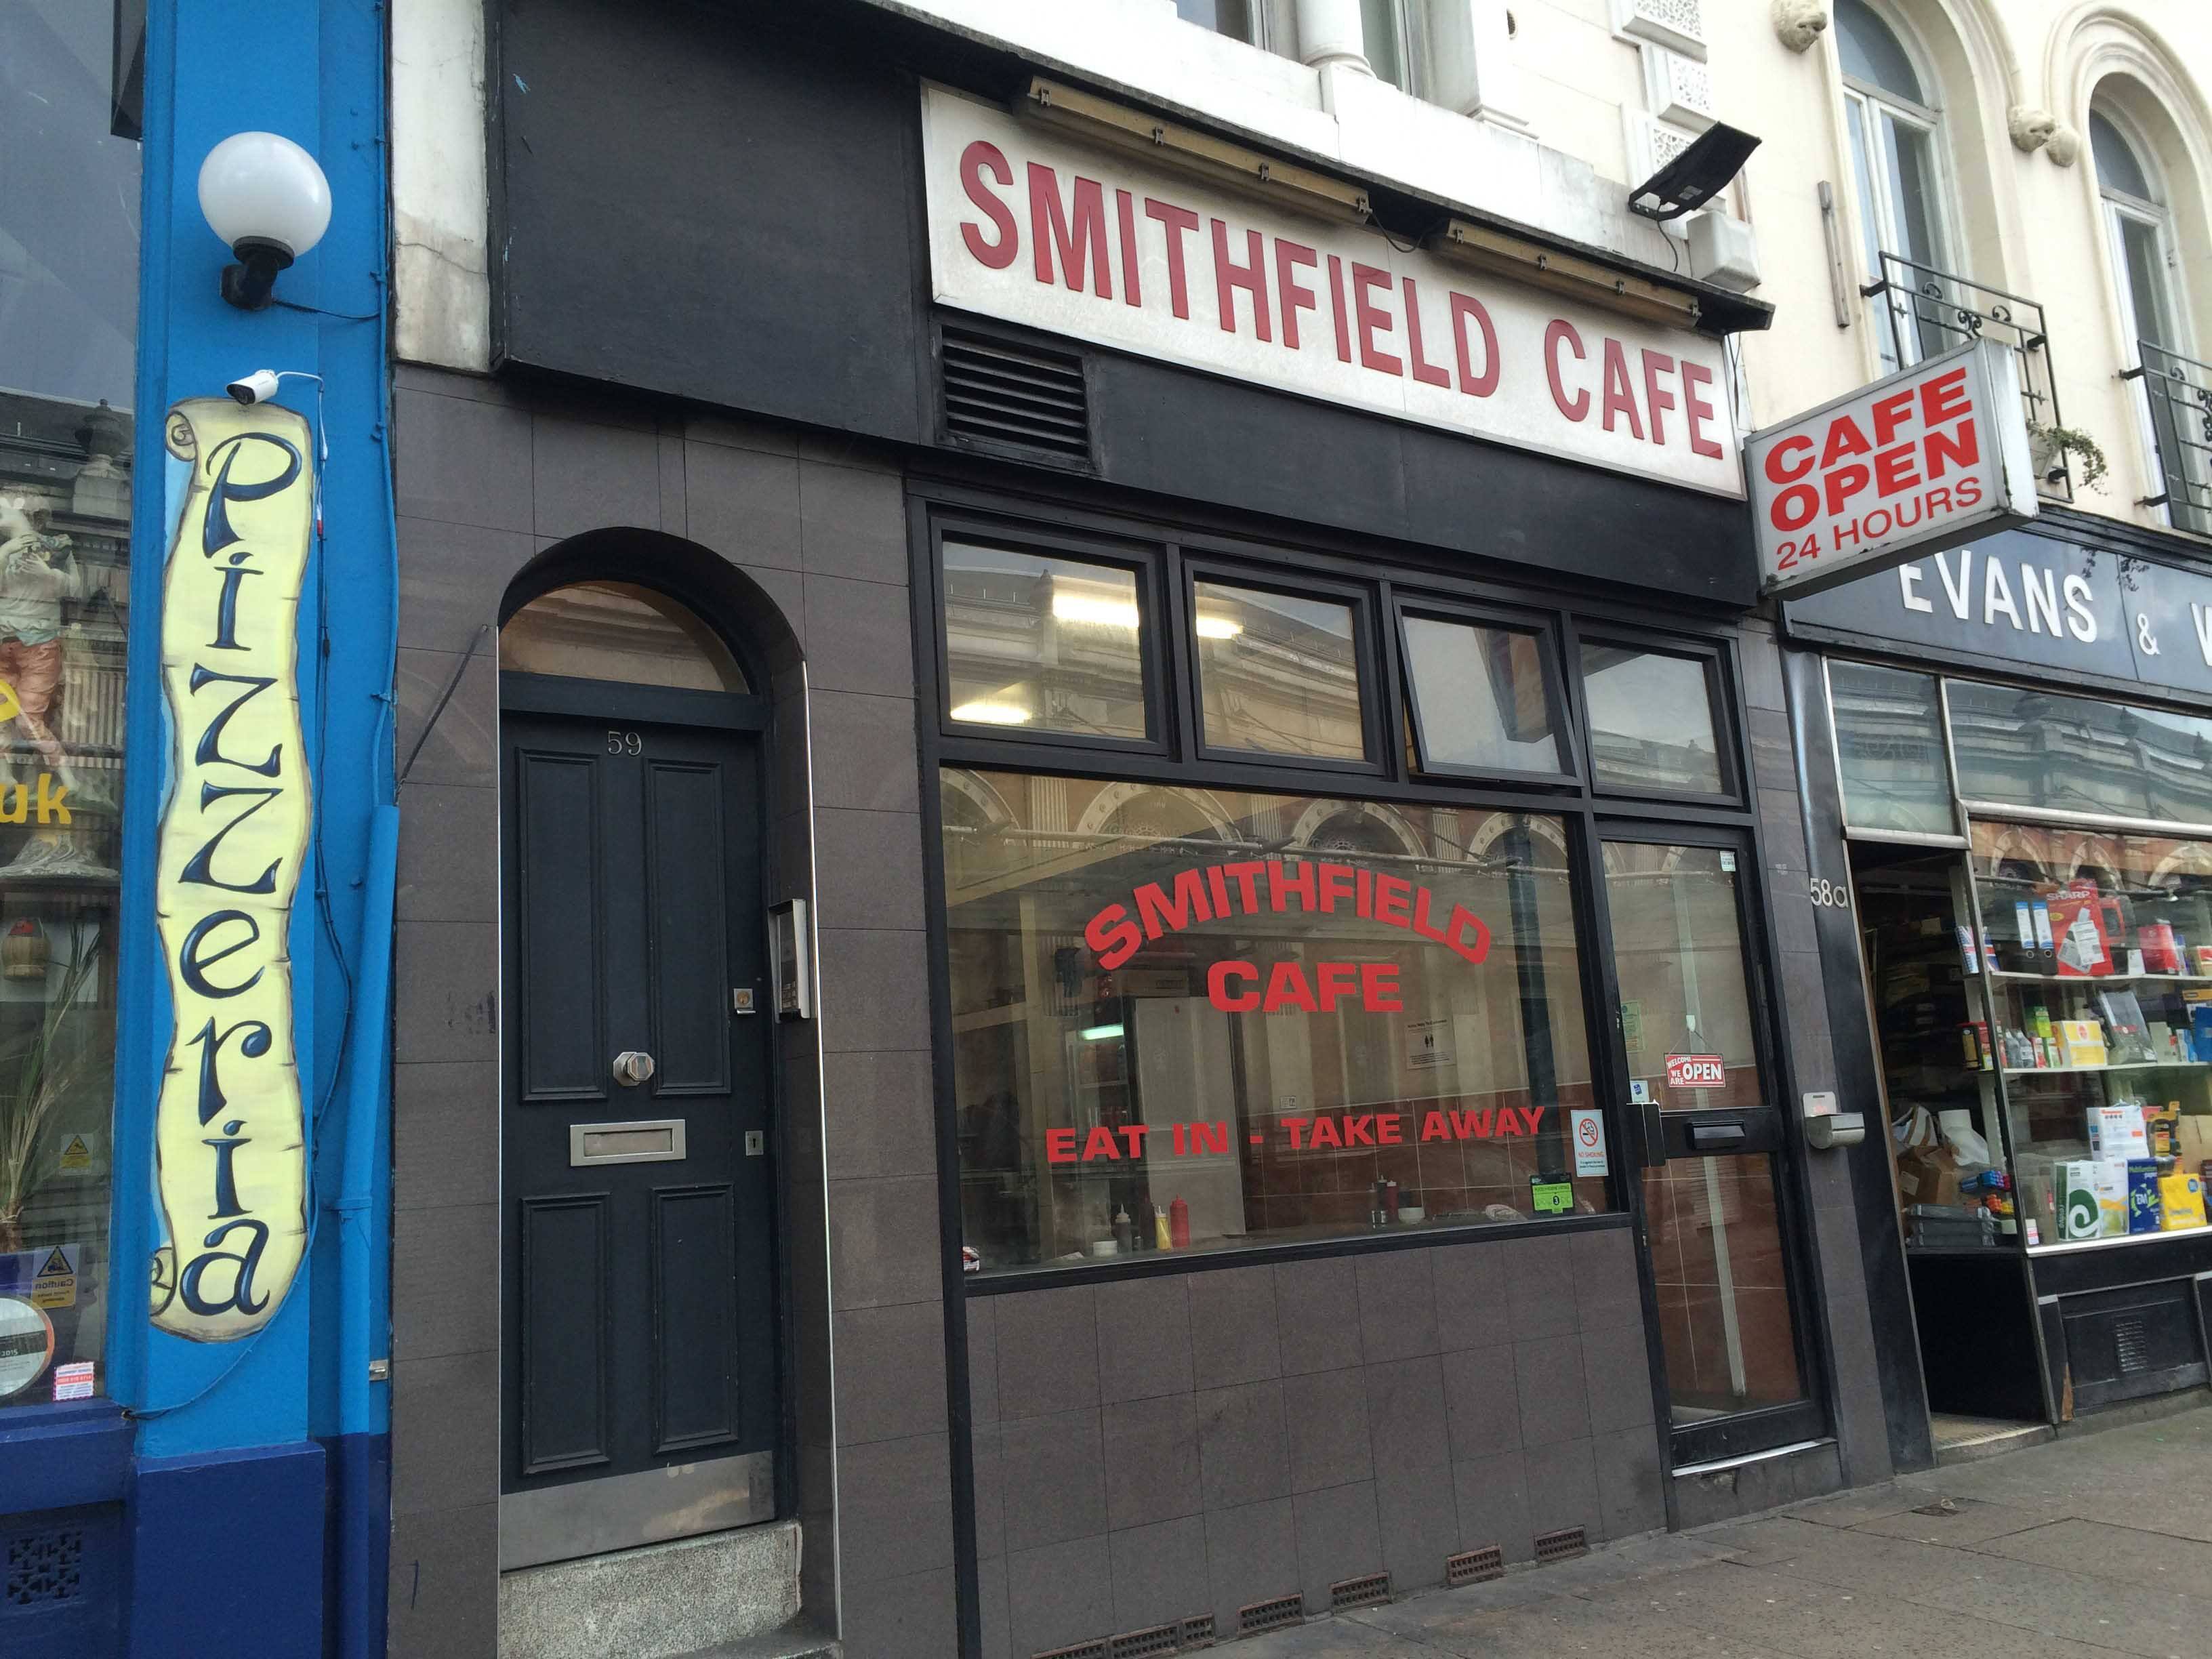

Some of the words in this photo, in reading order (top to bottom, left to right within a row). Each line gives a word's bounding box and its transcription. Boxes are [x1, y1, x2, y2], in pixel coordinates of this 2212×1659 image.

[960, 140, 1500, 398] SMITHFIELD
[1544, 319, 1723, 459] CAFE
[1765, 367, 1973, 484] CAFE
[1770, 418, 1980, 532] OPEN
[1777, 533, 1820, 571] 24
[1833, 476, 1982, 551] HOURS
[1898, 550, 2097, 642] EVANS
[2136, 613, 2160, 655] &
[607, 731, 642, 756] 59
[179, 432, 302, 1316] Pizzeria
[1810, 878, 1848, 907] 58a
[2046, 890, 2091, 900] SHARP
[1084, 861, 1492, 970] SMITHFIELD
[1208, 960, 1403, 1012] CAFE
[1667, 1057, 1692, 1069] WELCOME
[1682, 1063, 1722, 1080] OPEN
[1046, 1124, 1149, 1163] EAT
[1172, 1122, 1229, 1156] IN
[1281, 1113, 1403, 1150] TAKE
[1422, 1106, 1545, 1142] AWAY
